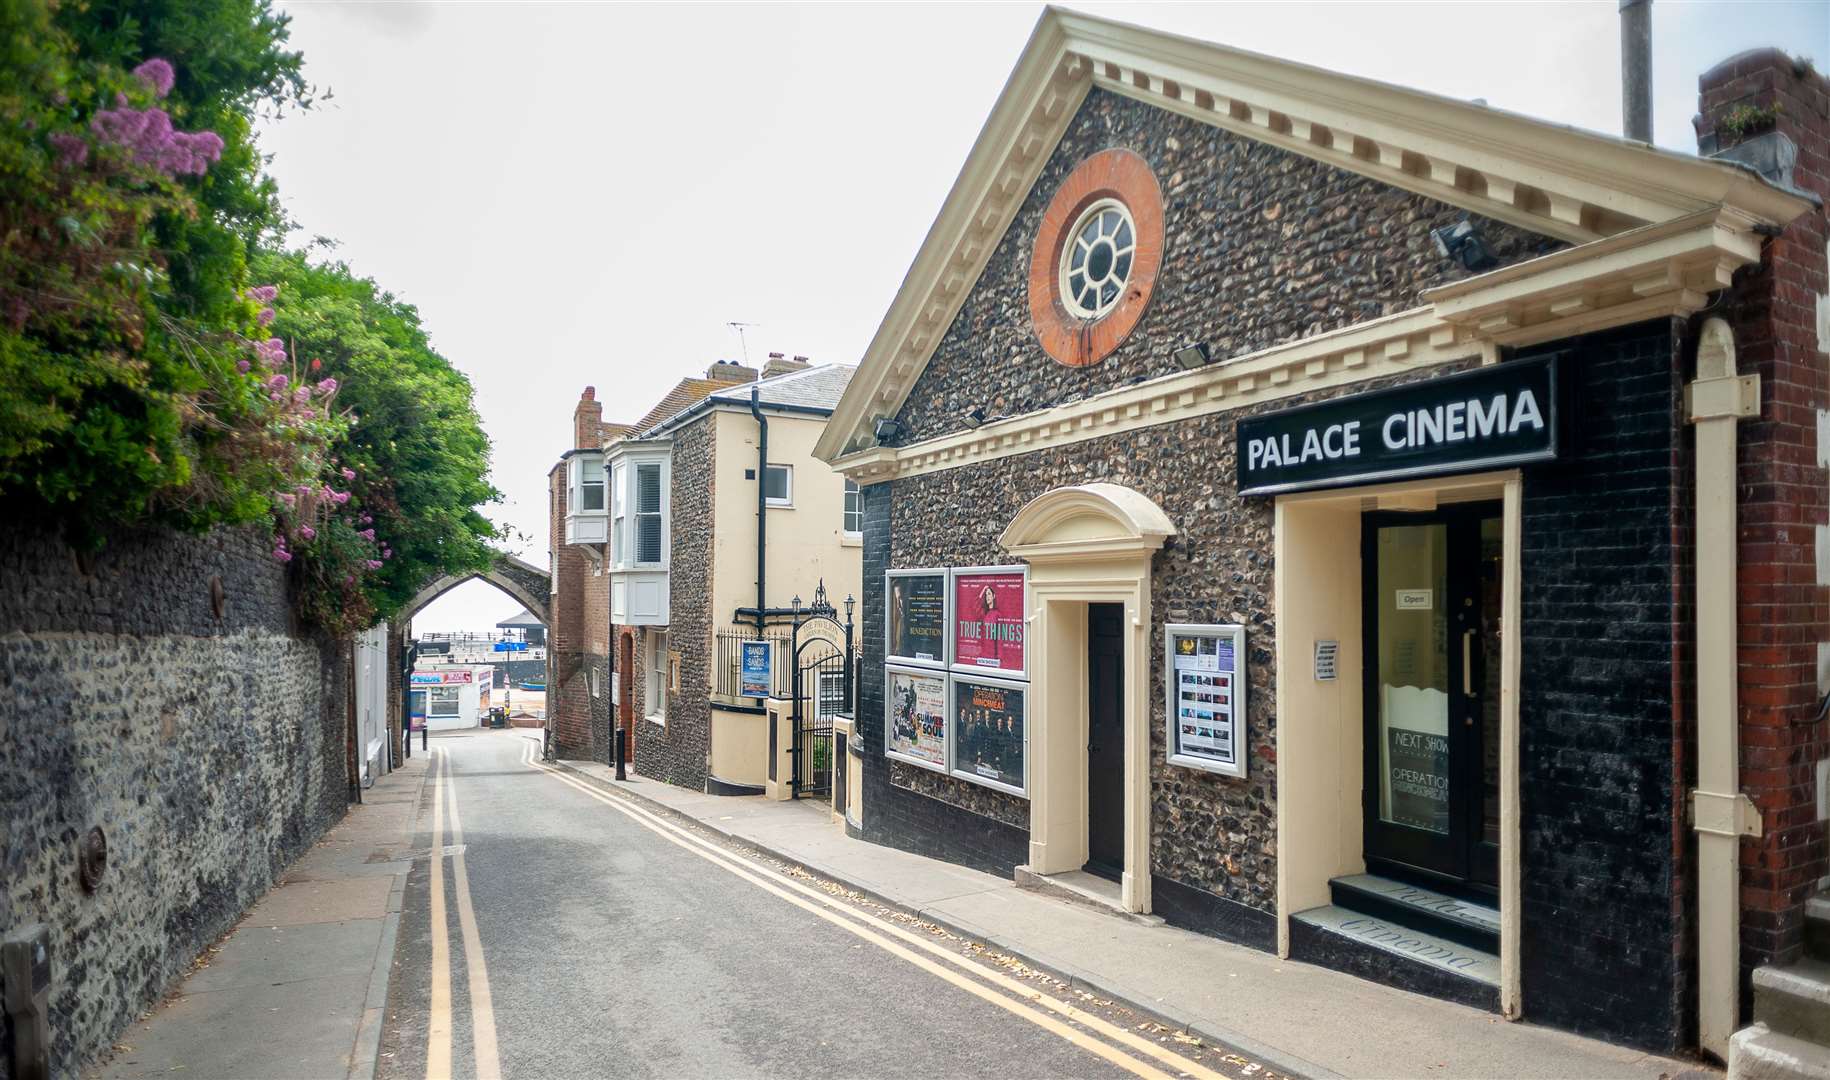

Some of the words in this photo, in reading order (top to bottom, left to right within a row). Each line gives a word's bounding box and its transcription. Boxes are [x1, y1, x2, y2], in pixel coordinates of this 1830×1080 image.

[1248, 421, 1361, 470] PALACE
[1382, 390, 1544, 449] CINEMA
[1404, 595, 1425, 604] Open
[960, 621, 982, 638] TRUE
[984, 622, 1022, 641] THINGS
[923, 724, 944, 737] SOUL
[1395, 732, 1422, 749] NEXT
[1339, 918, 1482, 970] Cinema
